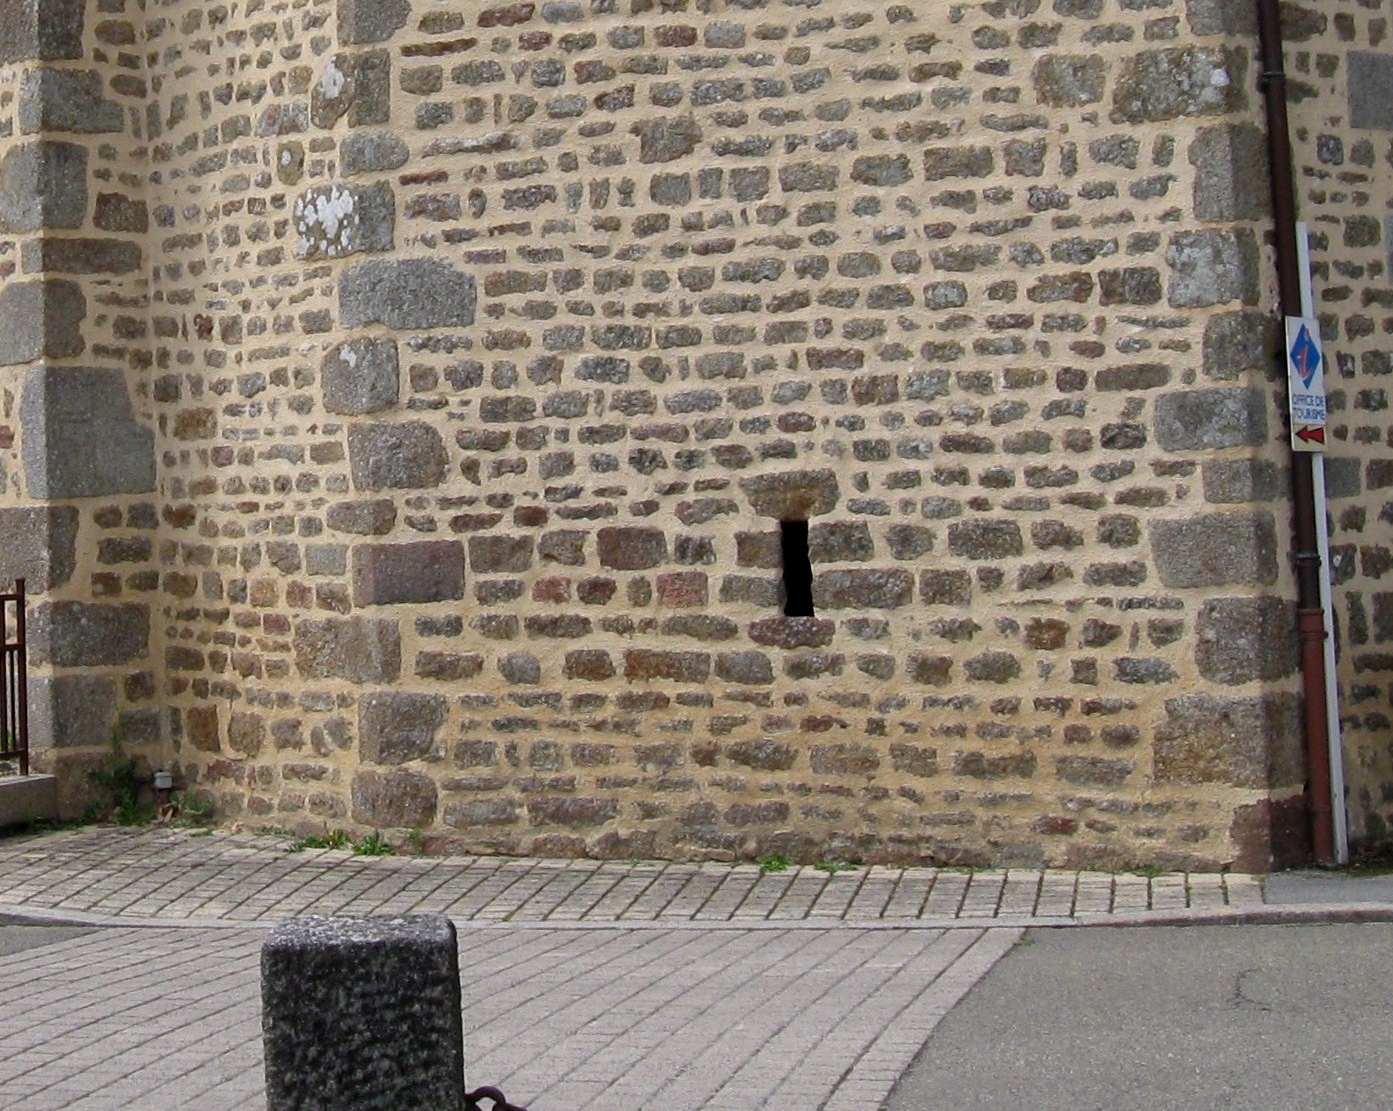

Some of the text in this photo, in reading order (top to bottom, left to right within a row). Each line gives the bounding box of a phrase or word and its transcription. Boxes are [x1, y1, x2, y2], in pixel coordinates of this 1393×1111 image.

[1292, 393, 1324, 408] OFFICE DE
[1293, 407, 1326, 421] TOURISME
